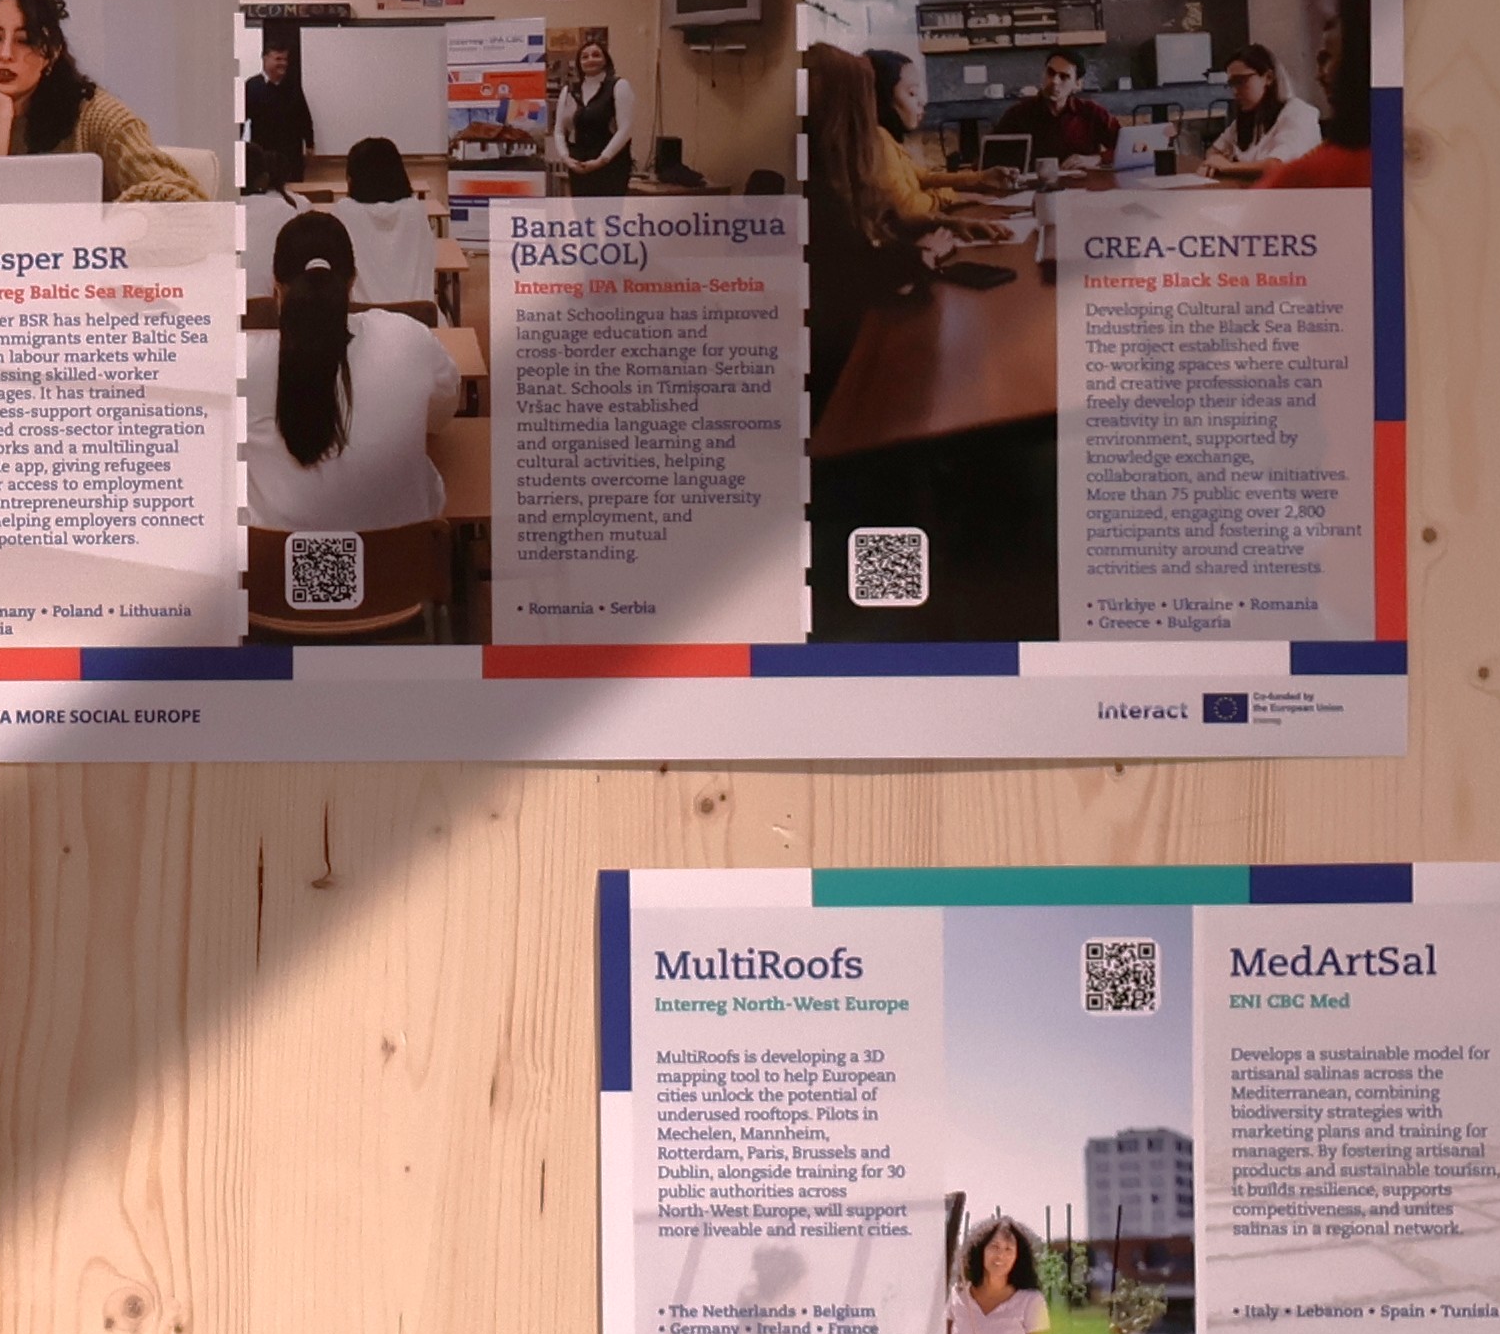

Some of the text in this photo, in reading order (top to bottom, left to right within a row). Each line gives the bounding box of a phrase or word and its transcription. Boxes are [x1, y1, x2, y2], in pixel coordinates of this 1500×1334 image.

[510, 211, 785, 243] Banat Schoolingua
[72, 246, 129, 270] BSR
[510, 240, 648, 274] (BASCOL)
[1084, 233, 1318, 260] CREA-CENTERS
[28, 283, 80, 301] Baltic
[84, 283, 118, 300] Sea
[121, 283, 184, 304] Region
[71, 530, 139, 547] workers.
[528, 599, 657, 615] Romania Serbia
[654, 946, 863, 981] MultiRoofs
[1229, 943, 1437, 977] MedArtSal
[1228, 991, 1351, 1009] ENI CBC Med
[1230, 1044, 1491, 1066] Develops a sustainable model for
